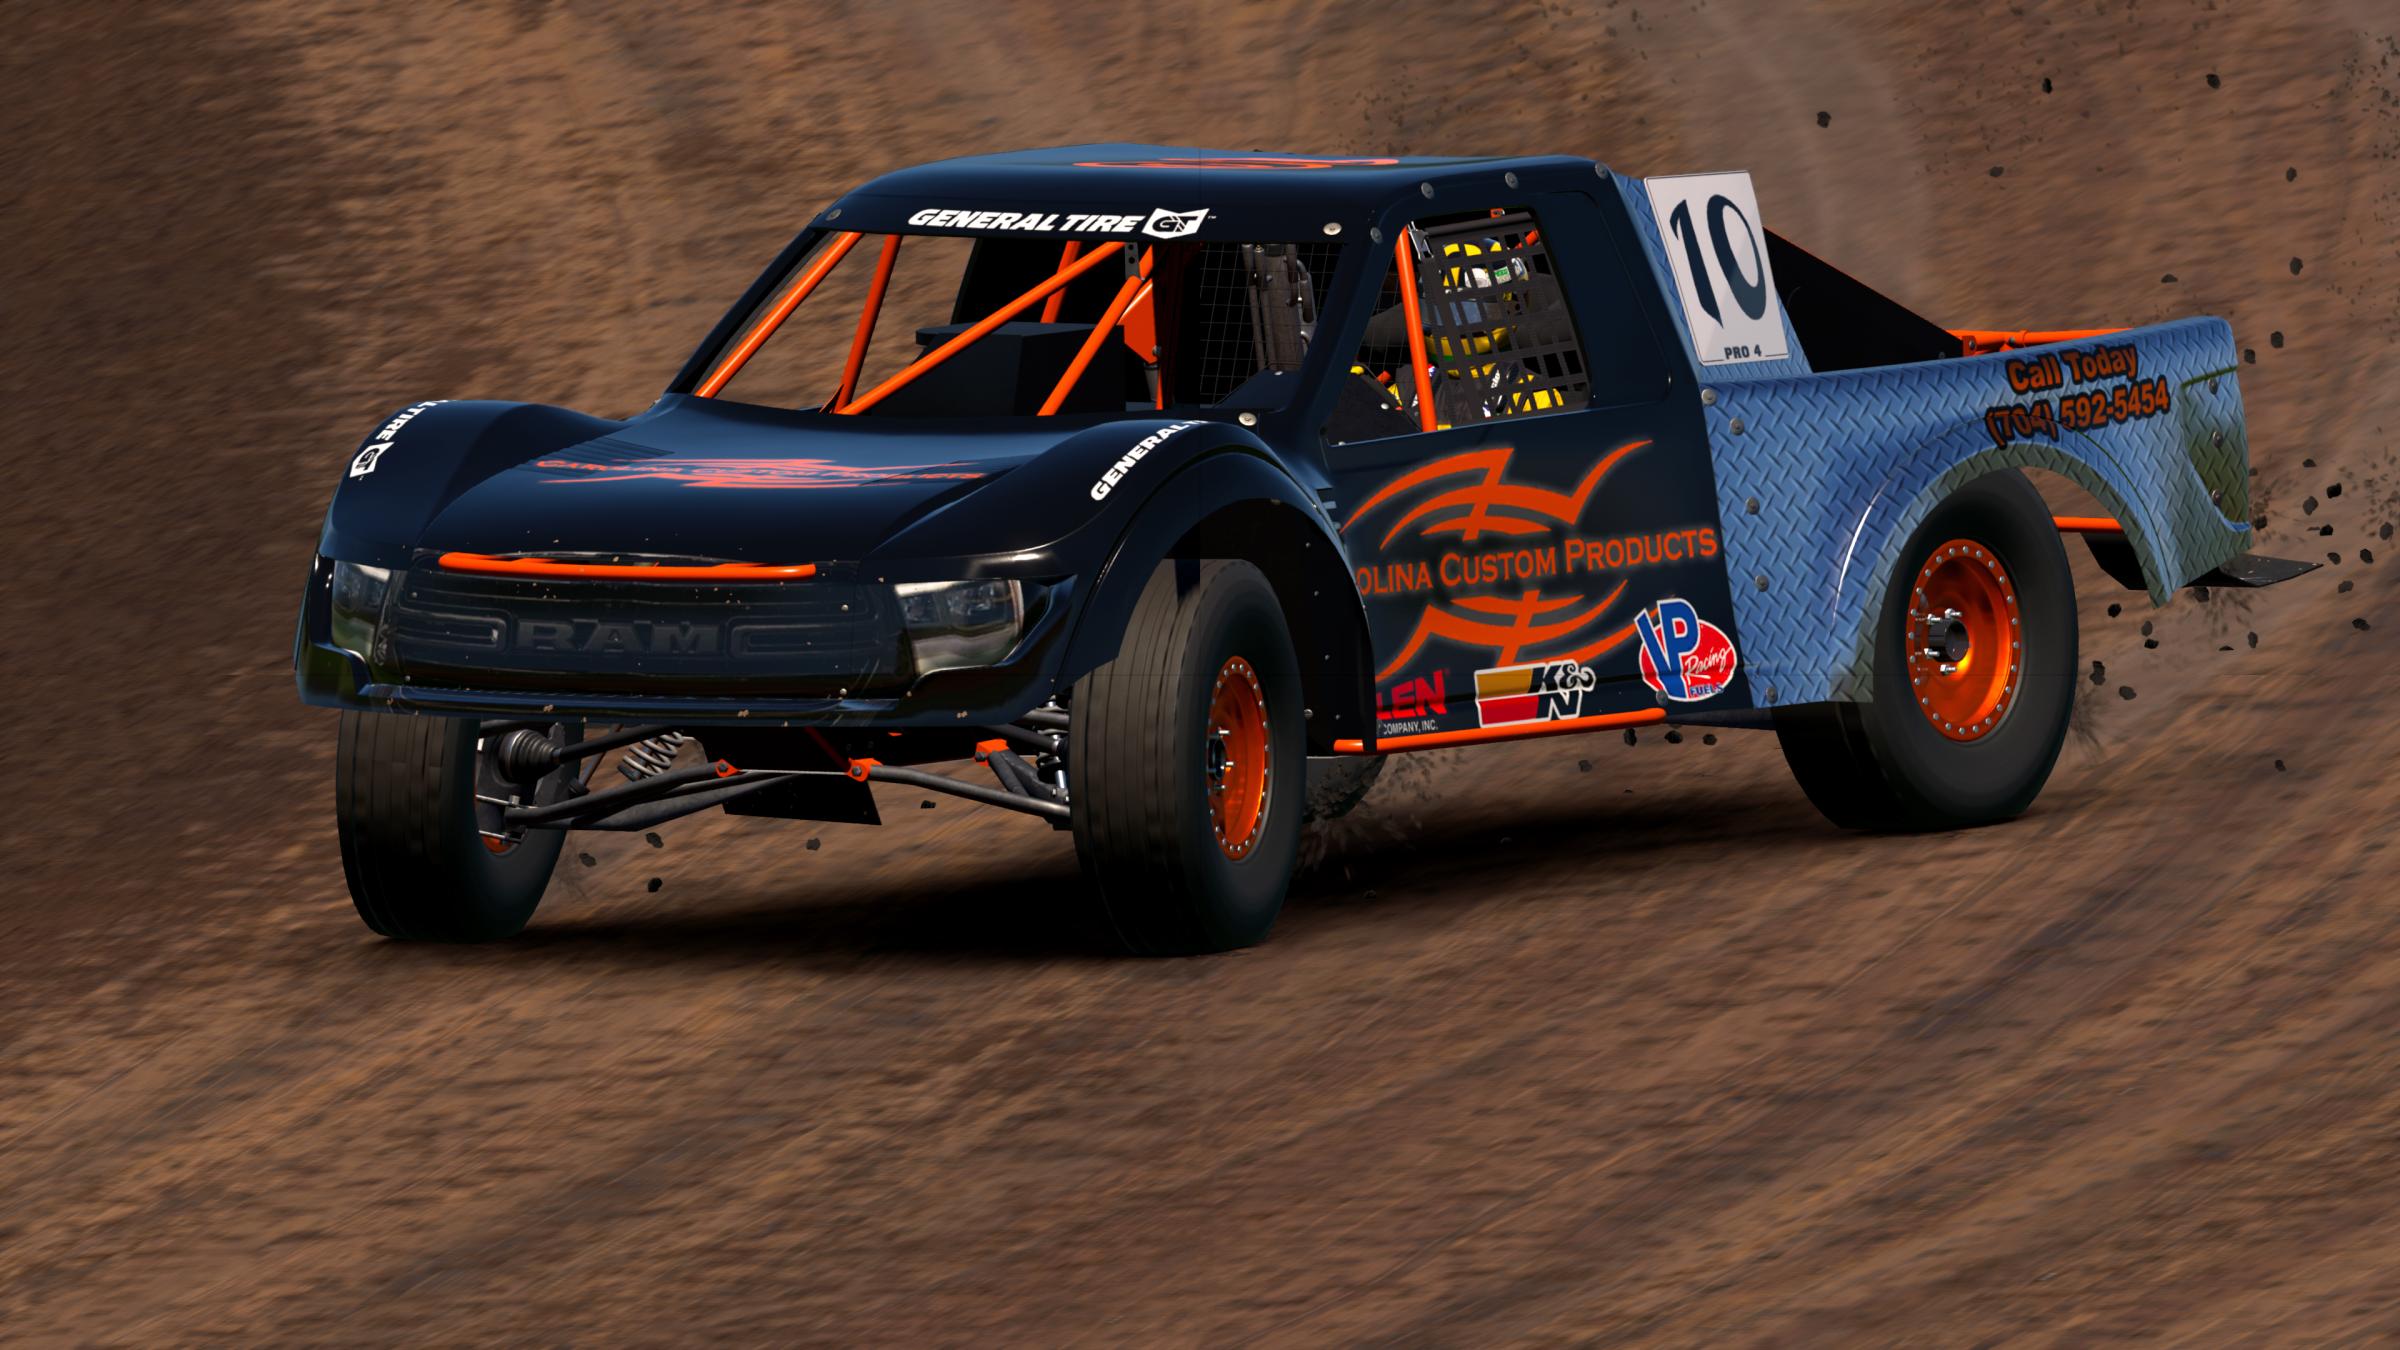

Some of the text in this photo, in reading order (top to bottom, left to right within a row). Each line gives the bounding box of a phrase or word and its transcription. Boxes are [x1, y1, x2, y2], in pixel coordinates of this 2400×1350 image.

[908, 208, 1059, 231] GENERAL
[1059, 214, 1147, 232] TIRE
[1670, 194, 1767, 329] 10
[1724, 344, 1762, 360] PRO 4
[2006, 344, 2138, 395] Call Today
[375, 407, 426, 441] TIRE
[1985, 374, 2171, 449] (704) 592-5454
[1090, 424, 1191, 501] GENERAL
[1355, 527, 1718, 596] OLINA CUSTOM PRODUCTS
[516, 618, 720, 655] RAM
[1634, 599, 1700, 701] VP
[1684, 646, 1732, 686] Racing
[1689, 682, 1724, 698] FUELS
[1376, 669, 1447, 720] LEN
